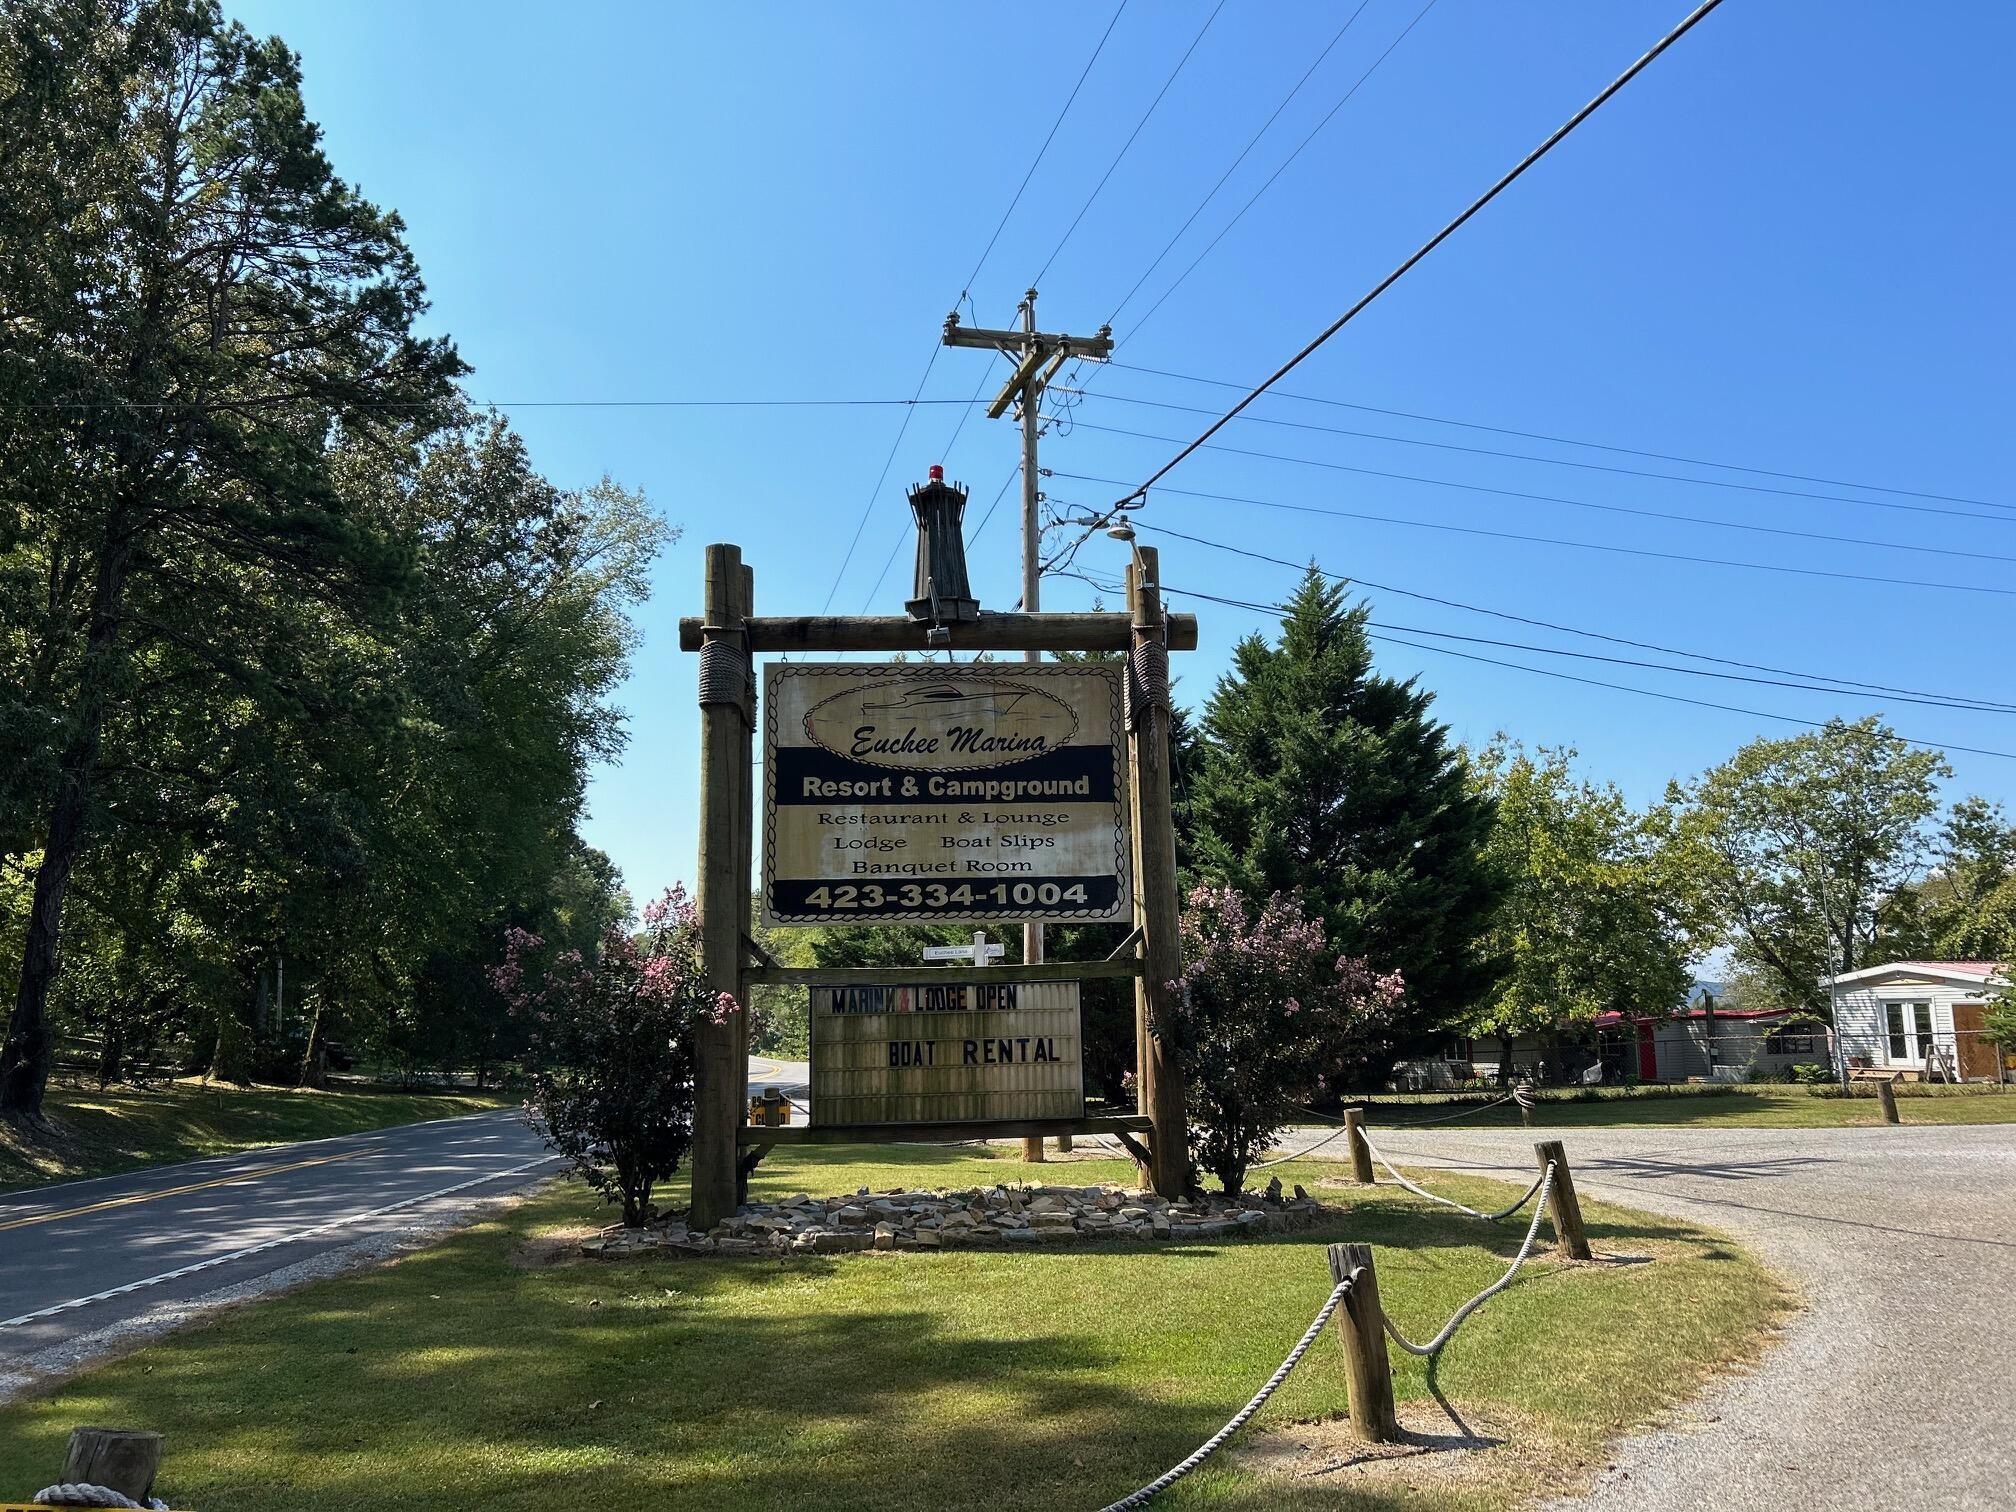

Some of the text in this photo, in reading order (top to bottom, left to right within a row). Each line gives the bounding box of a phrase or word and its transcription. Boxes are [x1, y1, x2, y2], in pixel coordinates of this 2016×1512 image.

[850, 725, 1048, 757] Euchee Marina
[803, 775, 1090, 801] Resort & Campground
[817, 811, 1070, 827] Restaurant & Lounge
[833, 834, 1055, 852] Lodge Boat Slips
[851, 860, 1033, 875] Banquet Room
[805, 883, 1088, 909] 423-334-1004
[915, 985, 968, 1011] LODGE
[976, 984, 1017, 1010] OPEN
[889, 1037, 1061, 1067] BOAT RENTAL
